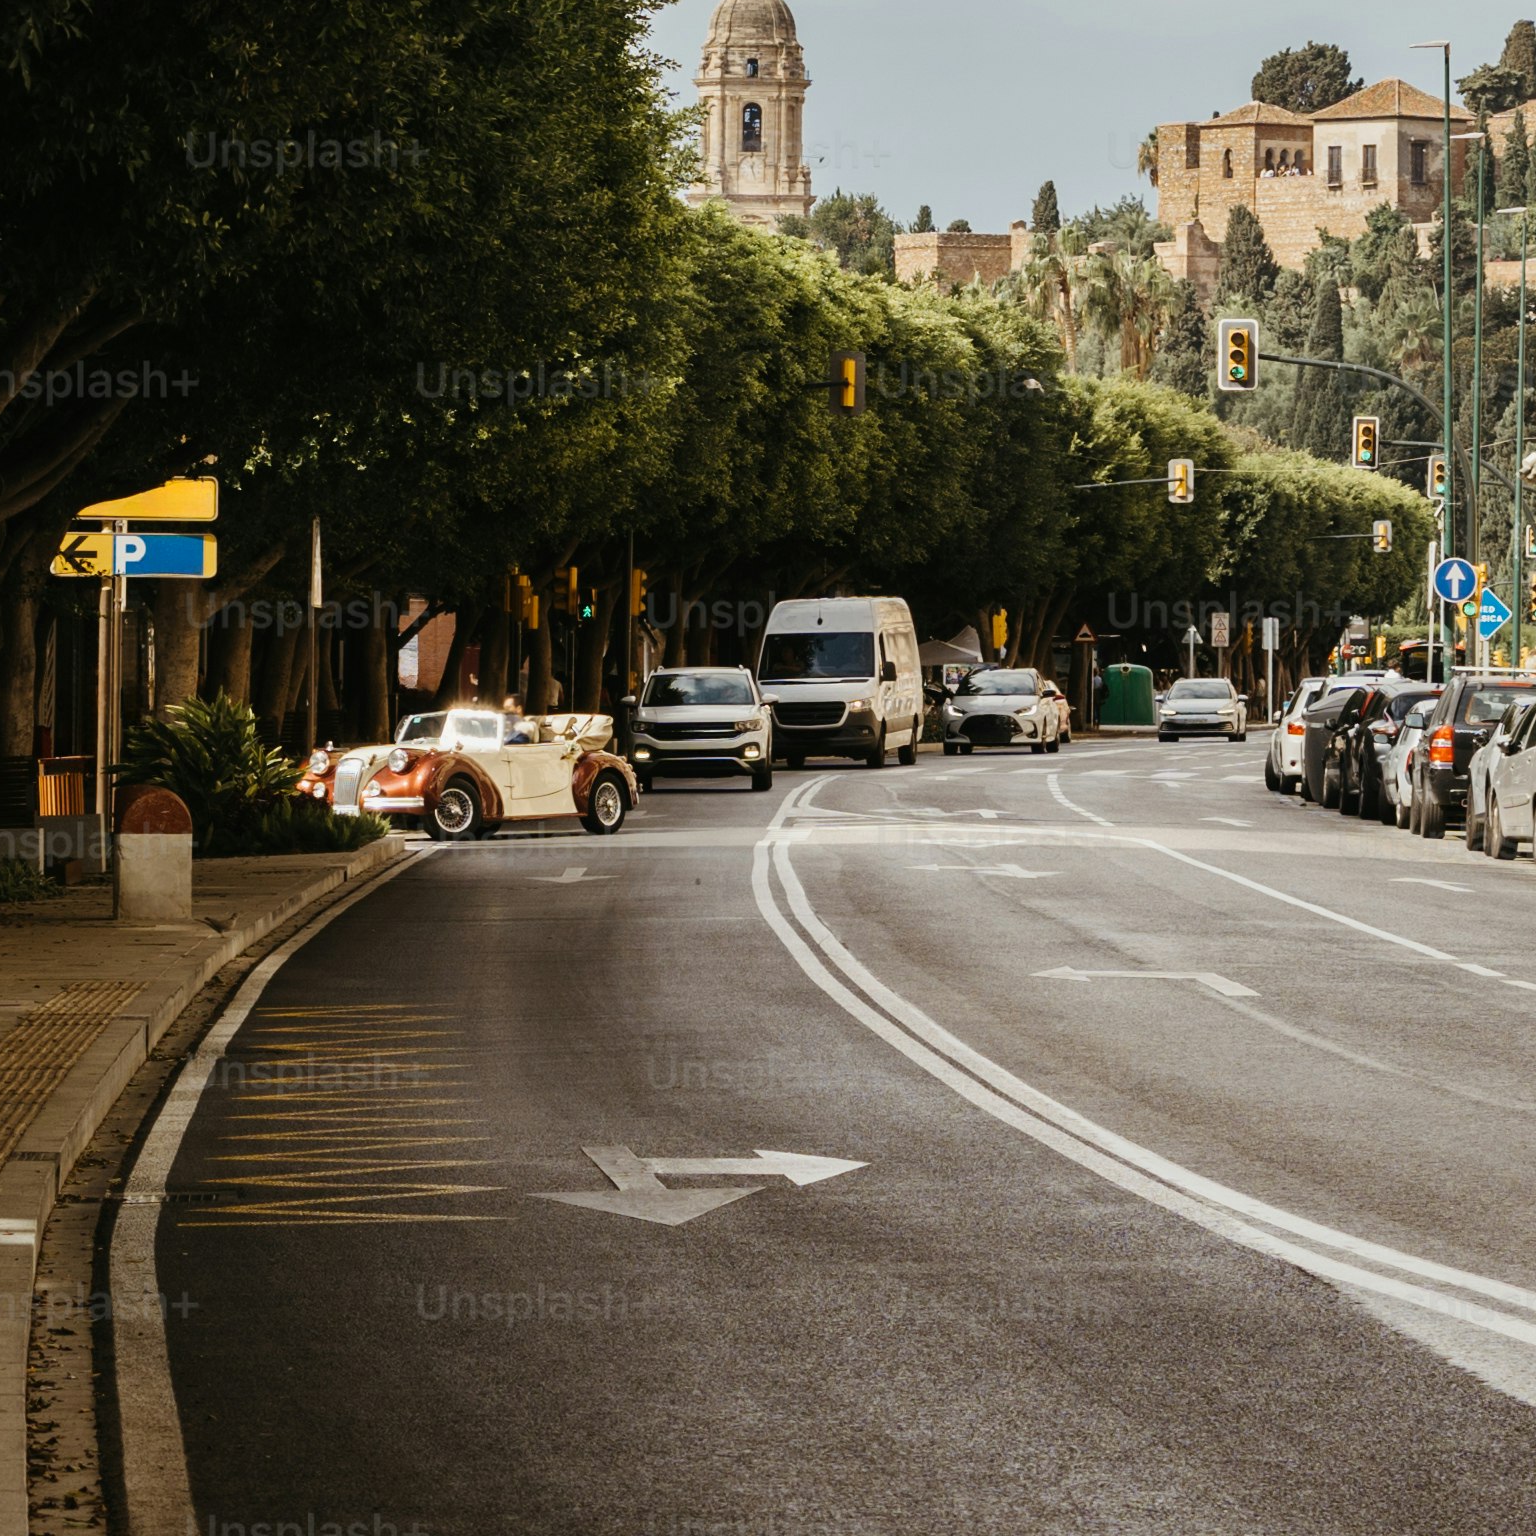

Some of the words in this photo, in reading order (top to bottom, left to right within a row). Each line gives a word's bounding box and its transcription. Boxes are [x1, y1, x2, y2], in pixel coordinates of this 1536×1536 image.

[115, 535, 147, 575] P
[1480, 614, 1503, 623] SICA
[1351, 645, 1367, 655] 2°C
